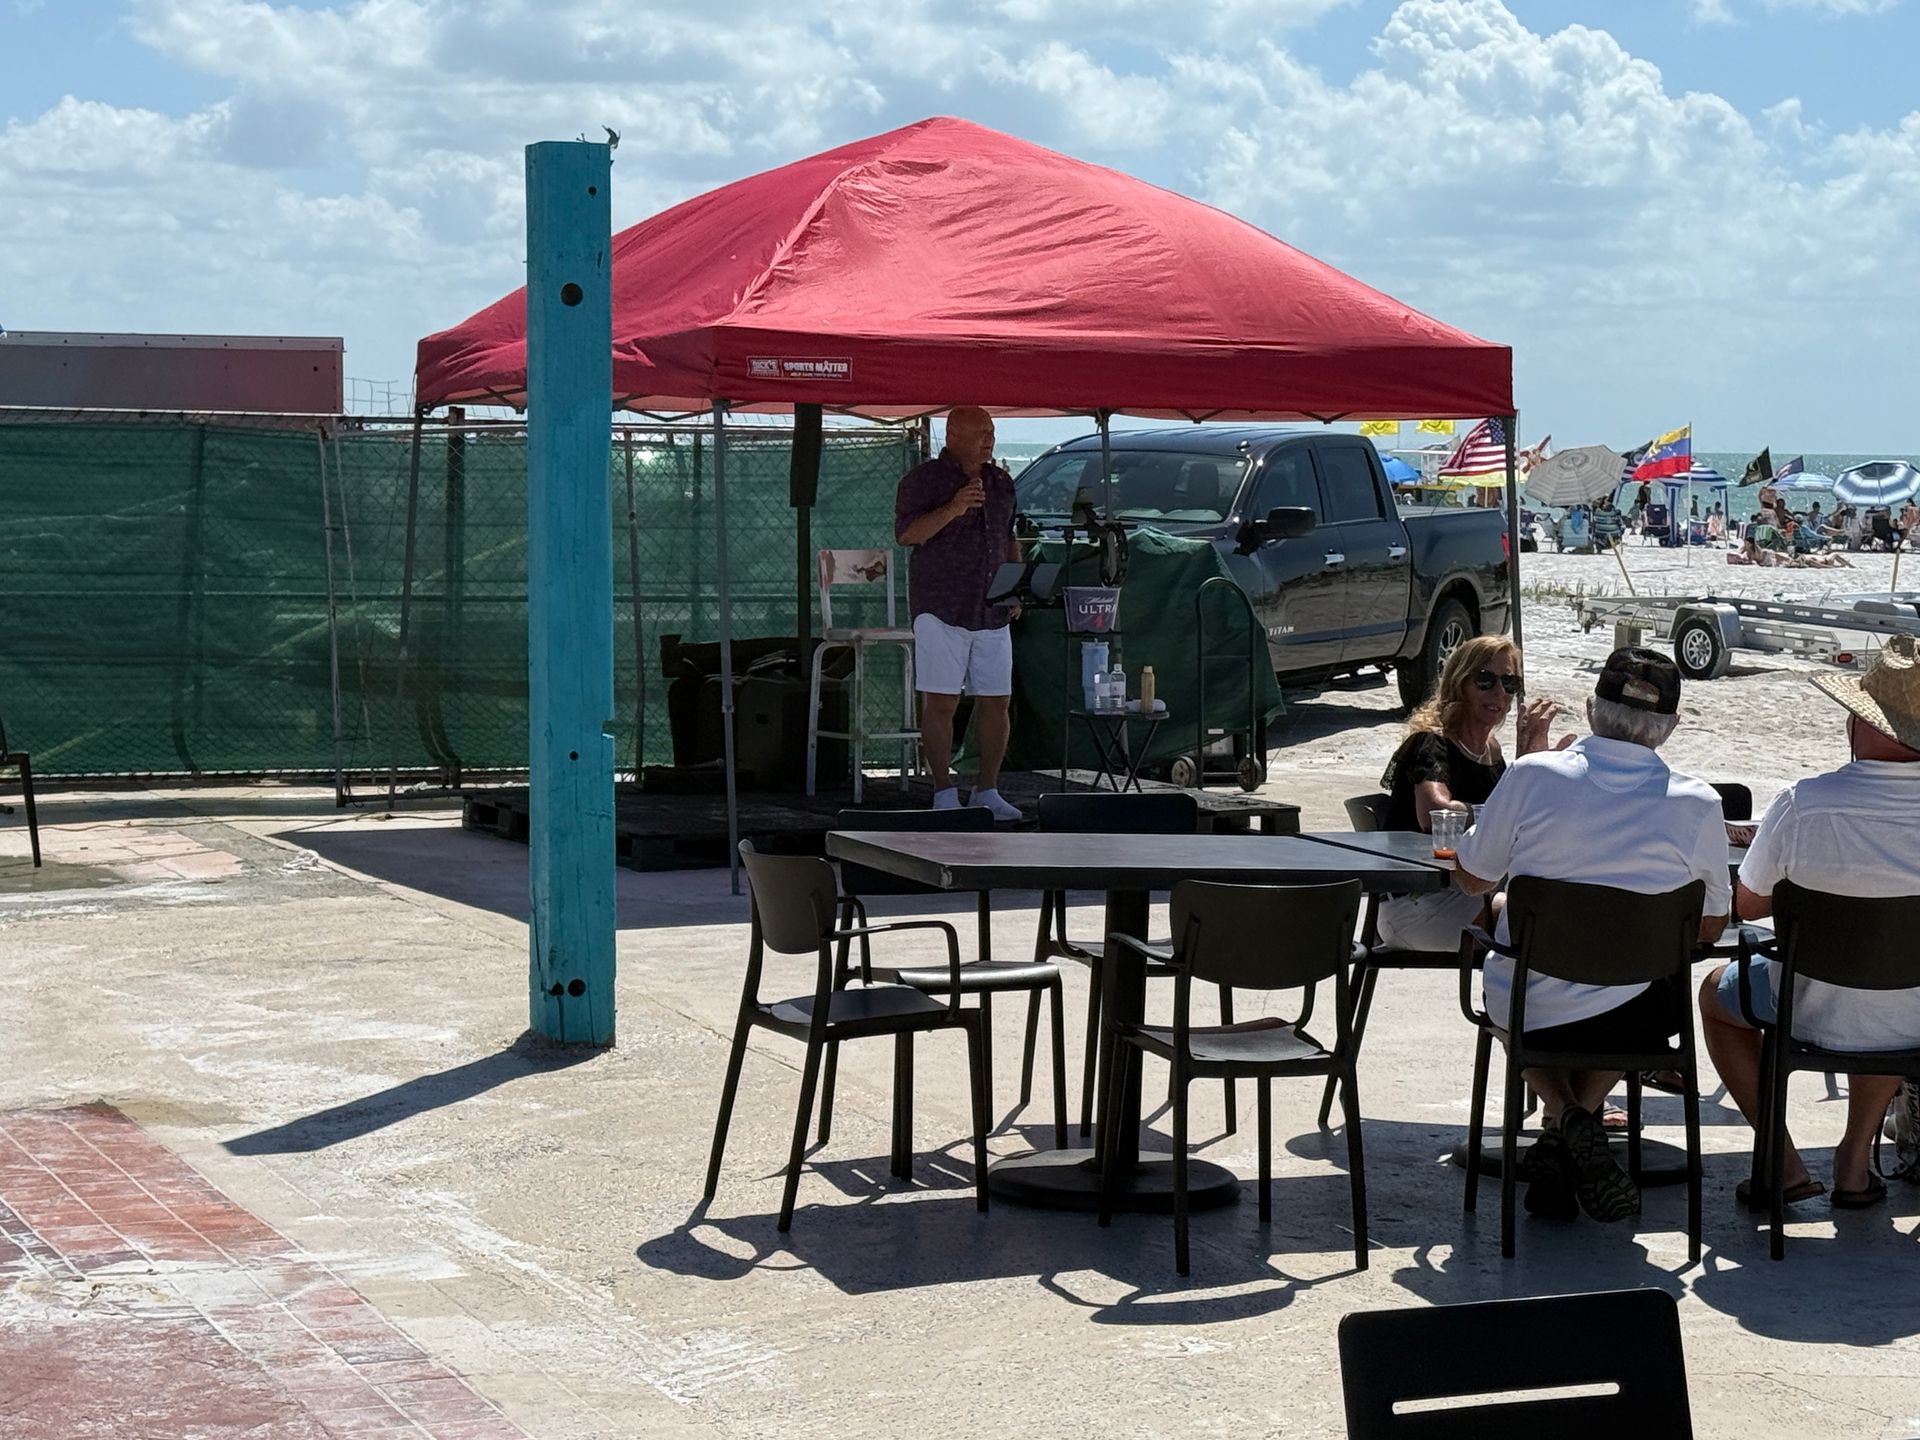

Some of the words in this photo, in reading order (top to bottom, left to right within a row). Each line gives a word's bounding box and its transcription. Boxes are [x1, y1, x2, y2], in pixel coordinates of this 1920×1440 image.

[783, 362, 814, 371] SPORTS
[815, 360, 848, 372] MATTER
[1268, 625, 1295, 636] TITAN
